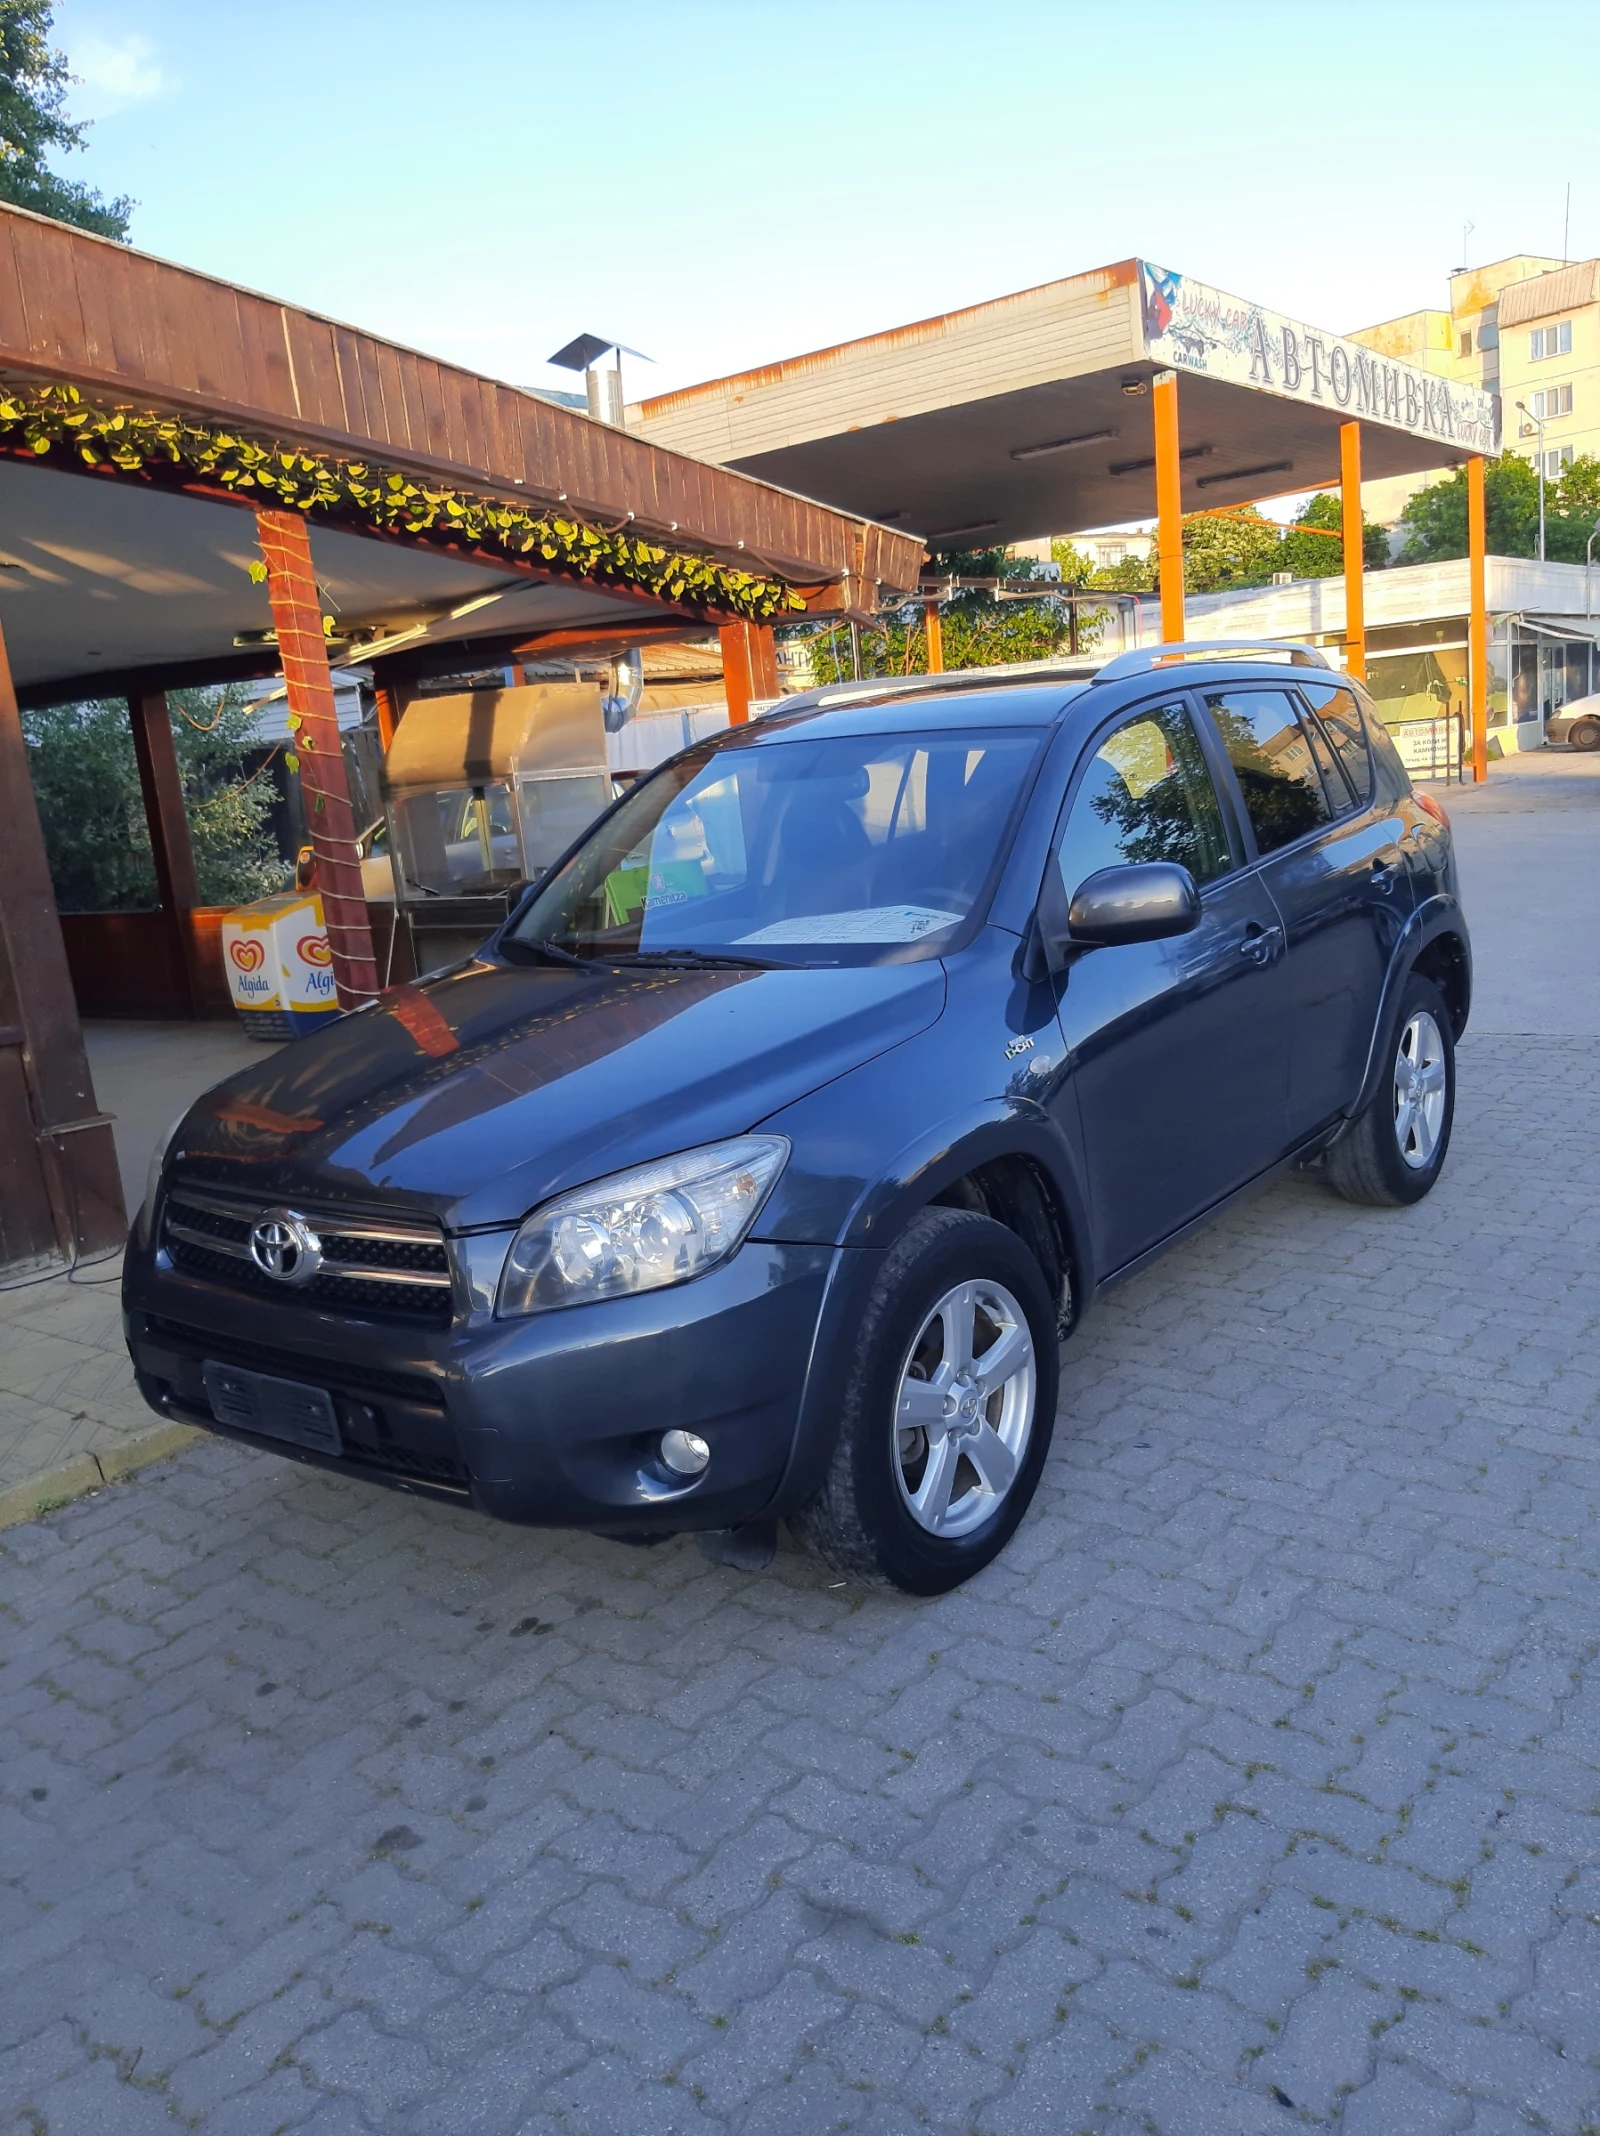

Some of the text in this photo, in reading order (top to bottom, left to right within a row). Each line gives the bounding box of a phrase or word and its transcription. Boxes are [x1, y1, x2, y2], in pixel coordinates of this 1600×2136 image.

[1182, 289, 1247, 332] LUCKY CAR
[1249, 314, 1455, 438] АВТОМИВКА
[641, 892, 687, 909] Kamenitza
[238, 974, 270, 999] Algida
[306, 970, 334, 996] Algi
